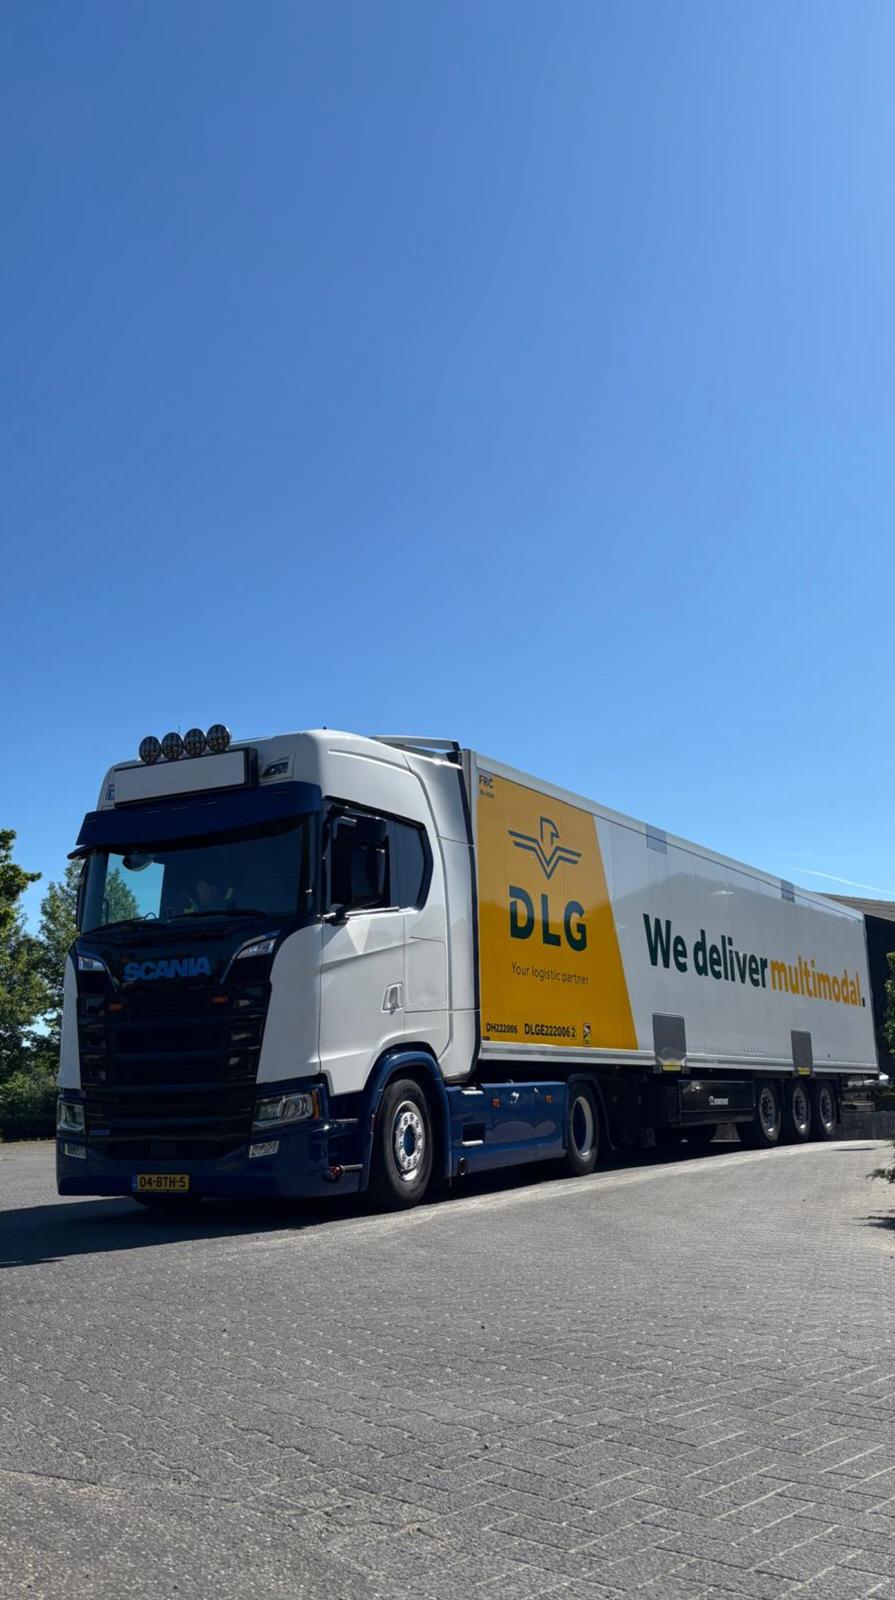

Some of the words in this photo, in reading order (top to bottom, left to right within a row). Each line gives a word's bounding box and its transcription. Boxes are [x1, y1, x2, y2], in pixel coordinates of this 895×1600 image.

[479, 775, 494, 789] FRC
[508, 885, 588, 952] DLG
[123, 956, 213, 981] SCANIA
[642, 913, 688, 973] We
[693, 928, 768, 988] deliver
[770, 955, 866, 1007] multimodal.
[511, 961, 530, 976] Your
[531, 966, 561, 982] logistic
[562, 971, 590, 985] partner
[139, 1176, 186, 1188] 04-BTH-5
